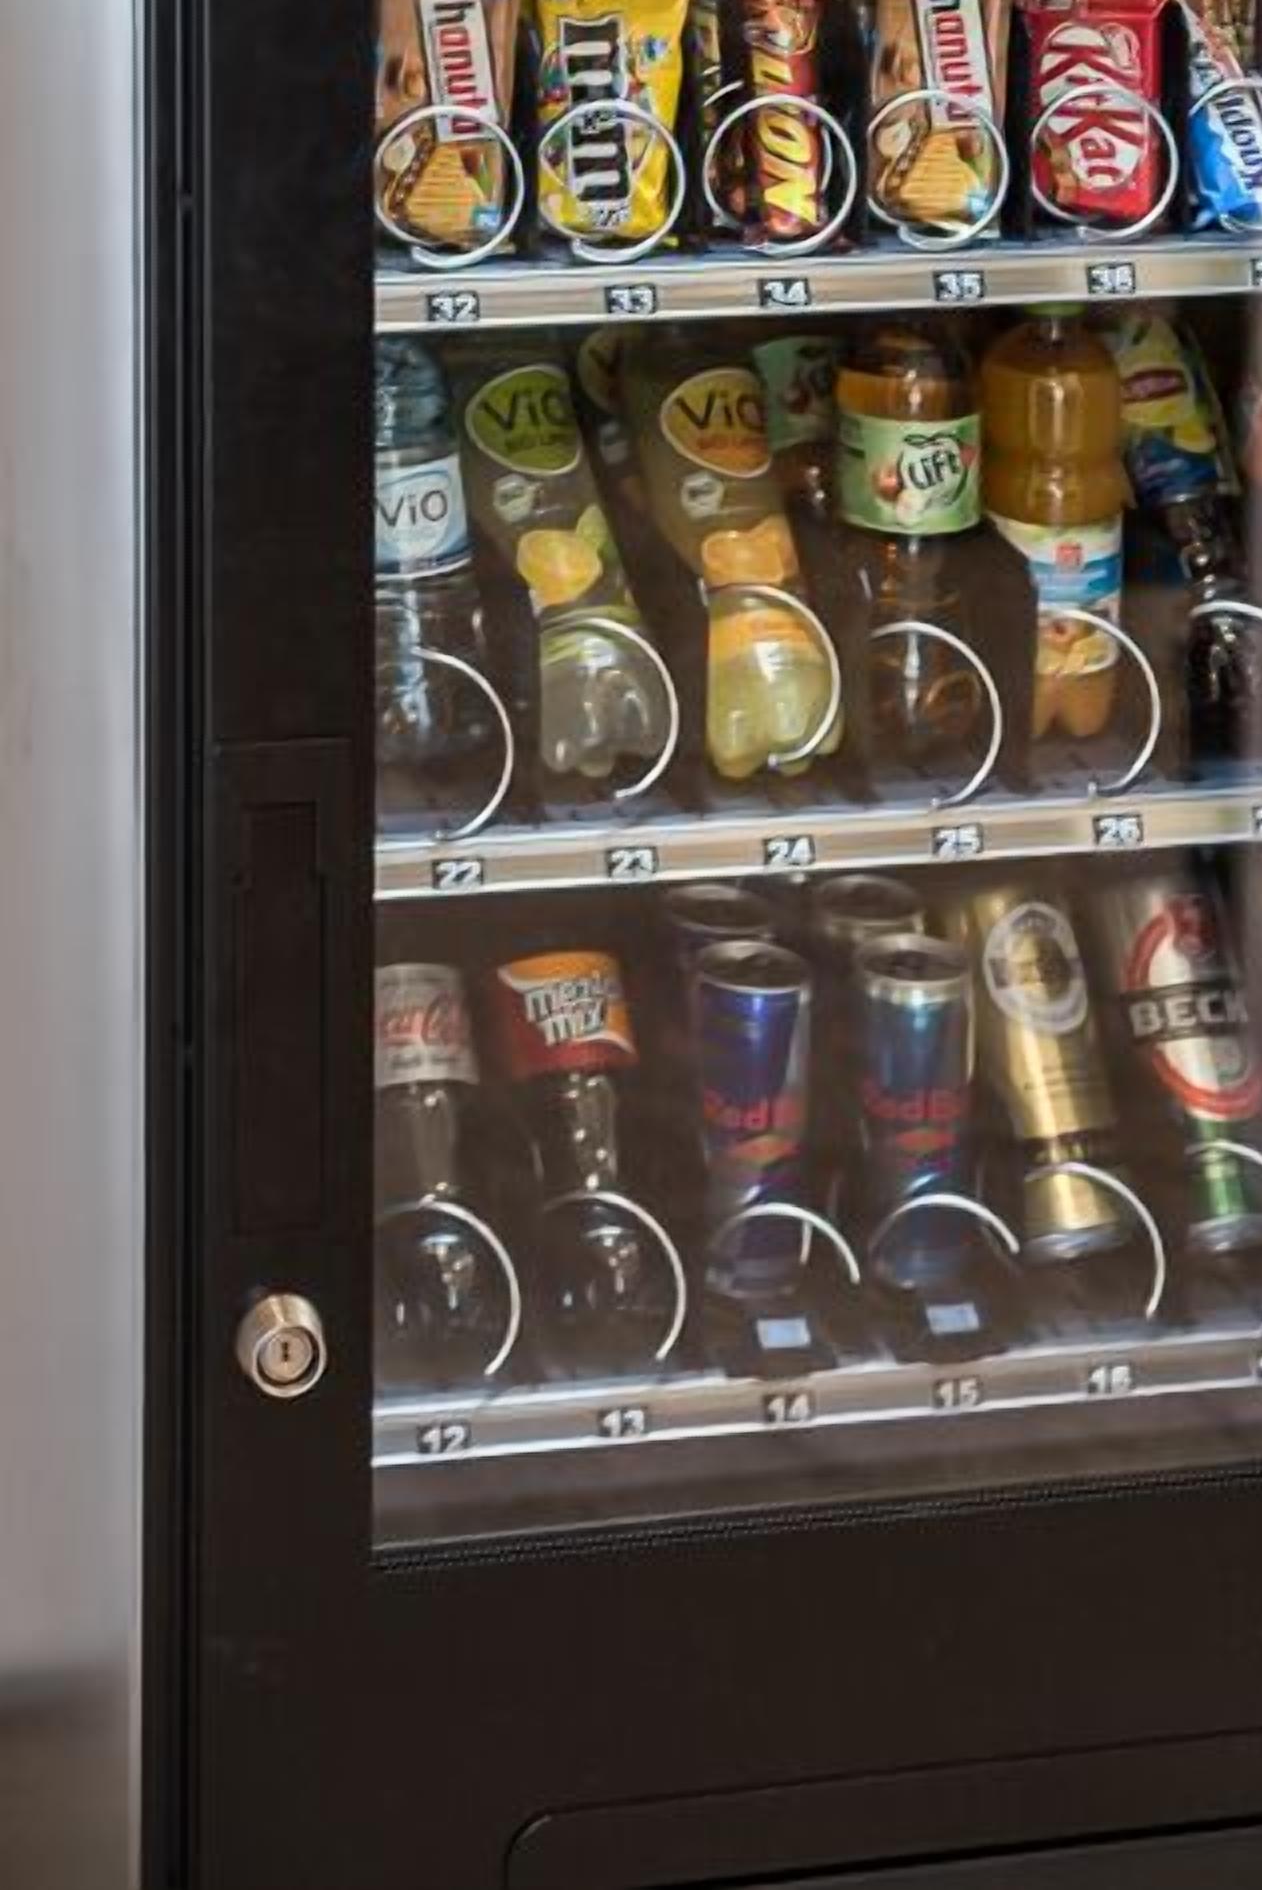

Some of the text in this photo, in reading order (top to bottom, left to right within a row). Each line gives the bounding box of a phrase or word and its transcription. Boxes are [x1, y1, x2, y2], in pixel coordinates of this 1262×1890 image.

[766, 837, 812, 867] 24
[436, 863, 482, 889] 22
[768, 1394, 810, 1422] 14
[422, 1424, 466, 1454] 12
